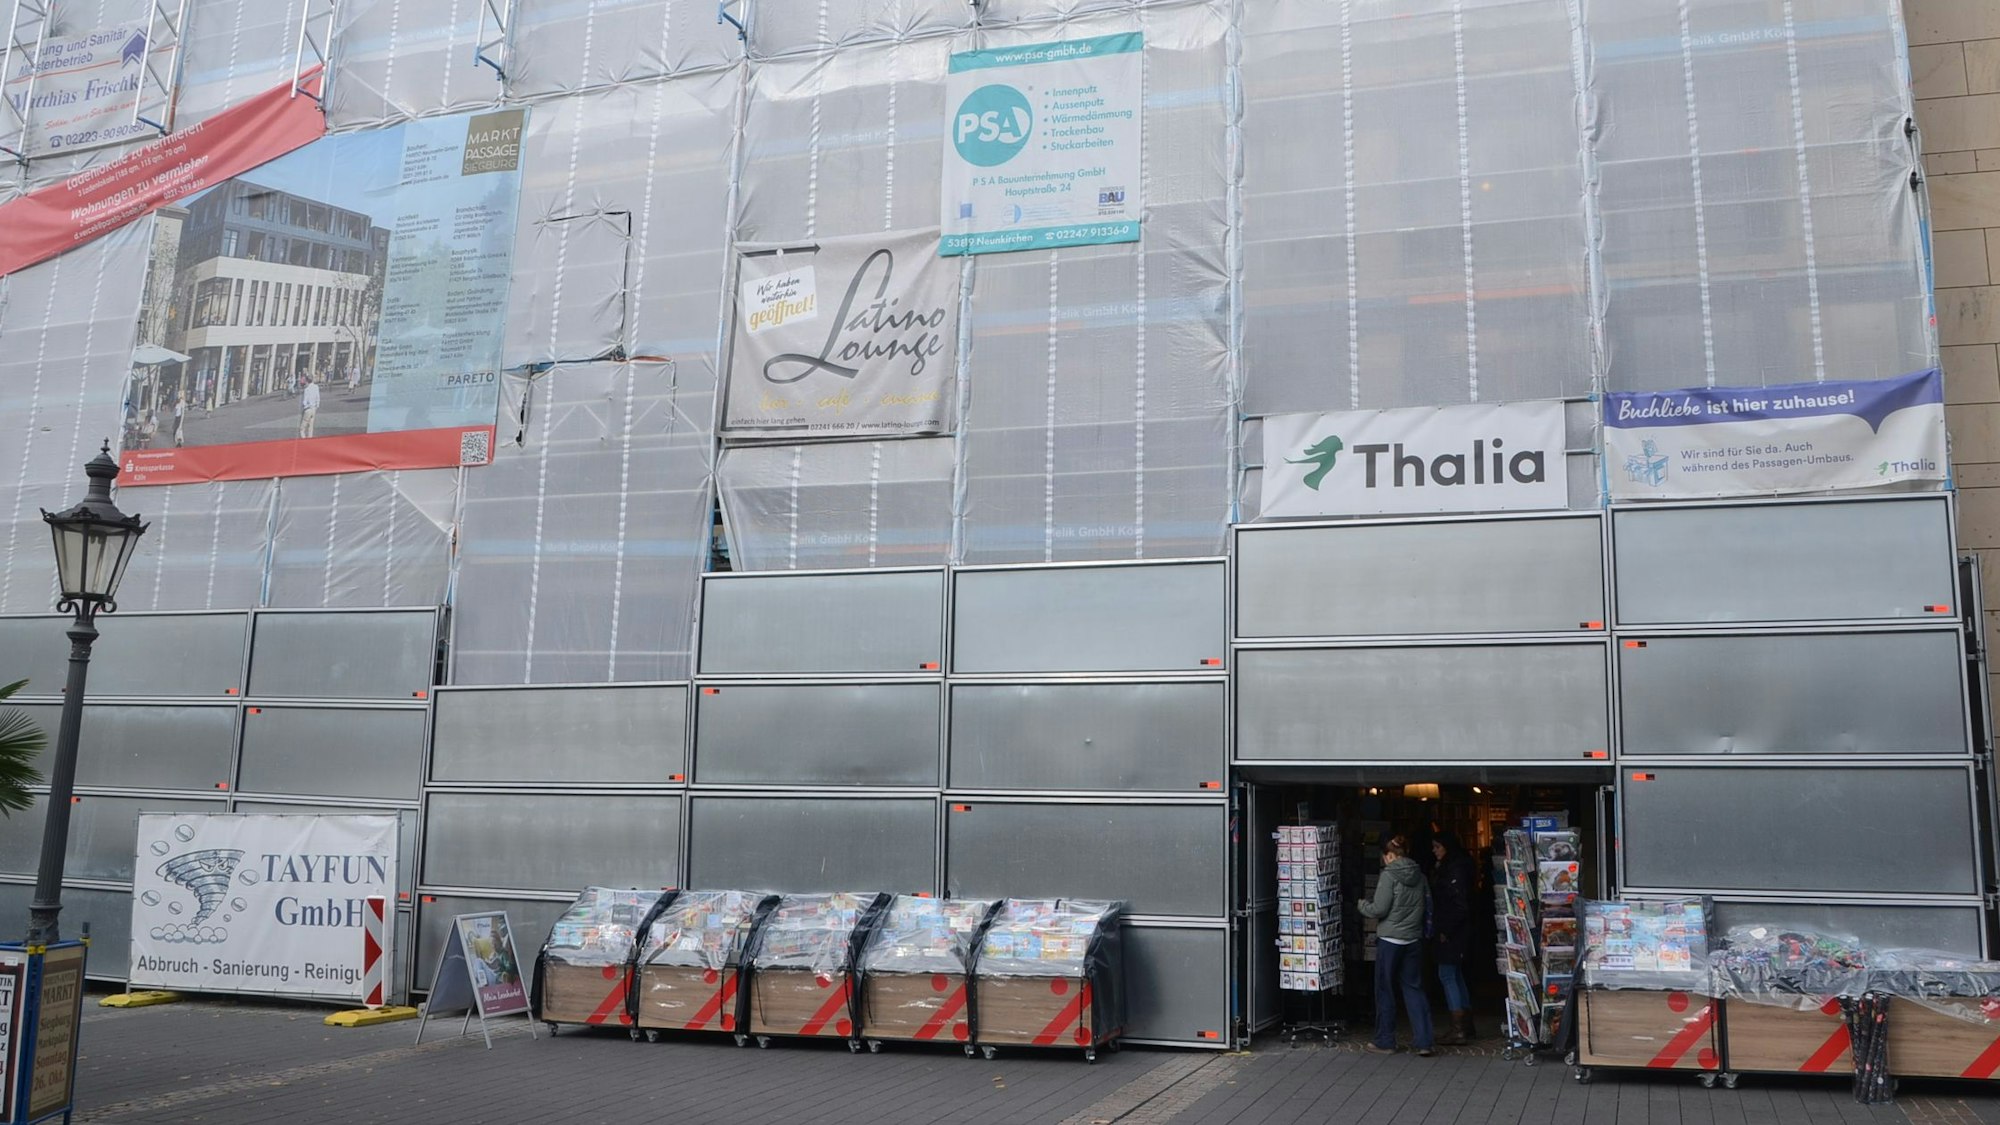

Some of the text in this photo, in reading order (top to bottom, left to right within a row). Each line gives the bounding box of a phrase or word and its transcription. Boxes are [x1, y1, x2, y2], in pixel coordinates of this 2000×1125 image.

[66, 39, 87, 52] und
[89, 29, 129, 48] Sanitär
[994, 44, 1092, 63] www.psa-gmbh.de
[1052, 85, 1098, 98] Innenputz
[1052, 98, 1105, 111] Aussenputz
[957, 106, 1031, 144] PSA
[1051, 108, 1133, 125] Wärmedämmung
[467, 126, 520, 146] MARKT
[1050, 125, 1105, 138] Trockenbau
[465, 143, 519, 161] PASSAGE
[1050, 138, 1114, 152] Stuckarbeiten
[67, 122, 204, 192] Ladenlokale zu vermieten
[463, 159, 517, 174] SIEGBURG
[972, 167, 1106, 187] P S A Bauunternehmung GmbH
[71, 185, 136, 220] Wohnungen
[137, 180, 150, 192] zu
[151, 155, 209, 186] vermieten
[1005, 183, 1072, 199] Hauptstraße 24
[1099, 190, 1125, 203] BAU
[976, 233, 1034, 247] Neunkirchen
[1056, 228, 1089, 240] 02247
[1090, 225, 1130, 238] 91336-0
[757, 277, 800, 296] Wir haben
[760, 289, 797, 304] weiterhin
[749, 294, 815, 333] geöffnet!
[447, 372, 495, 386] PARETO
[1618, 389, 1855, 421] Buchliebe ist hier zuhause!
[756, 417, 769, 425] hier
[770, 417, 785, 425] lang
[785, 416, 805, 425] gehen
[846, 422, 855, 430] 20
[1681, 441, 1813, 460] Wir sind für Sie da. Auch
[1353, 438, 1545, 488] Thalia
[1682, 454, 1855, 473] während des Passagen-Umbaus.
[1891, 459, 1936, 474] Thalia
[261, 854, 389, 885] TAYFUN
[274, 896, 365, 928] GmbH
[137, 955, 199, 974] Abbruch
[212, 959, 289, 982] Sanierung
[304, 963, 363, 985] Reinigu
